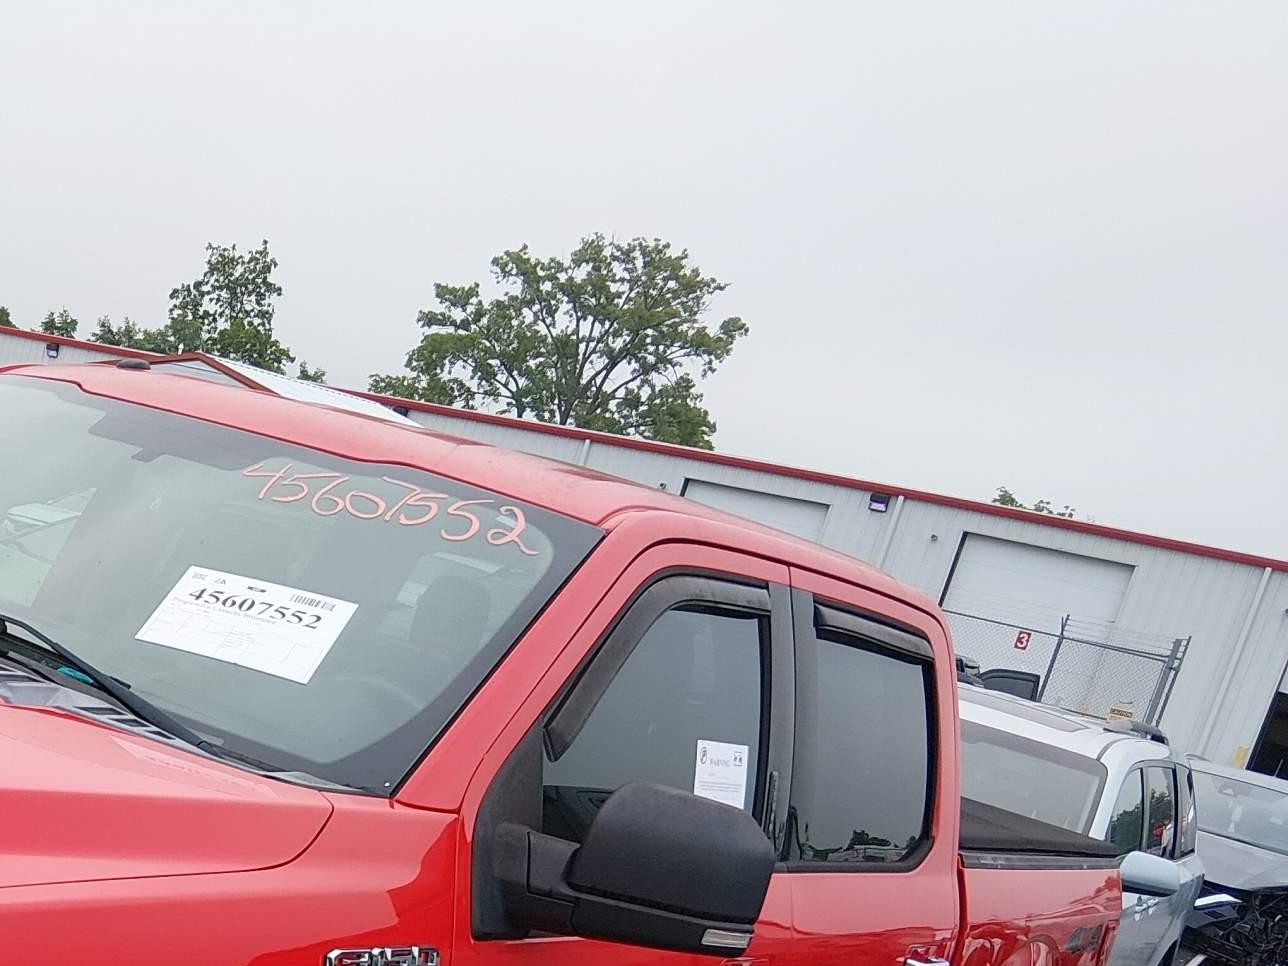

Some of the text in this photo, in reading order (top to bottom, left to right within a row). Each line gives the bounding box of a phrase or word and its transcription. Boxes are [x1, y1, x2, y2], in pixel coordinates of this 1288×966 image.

[242, 462, 540, 556] 45607552
[188, 586, 323, 630] 45607552
[1015, 632, 1030, 649] 3
